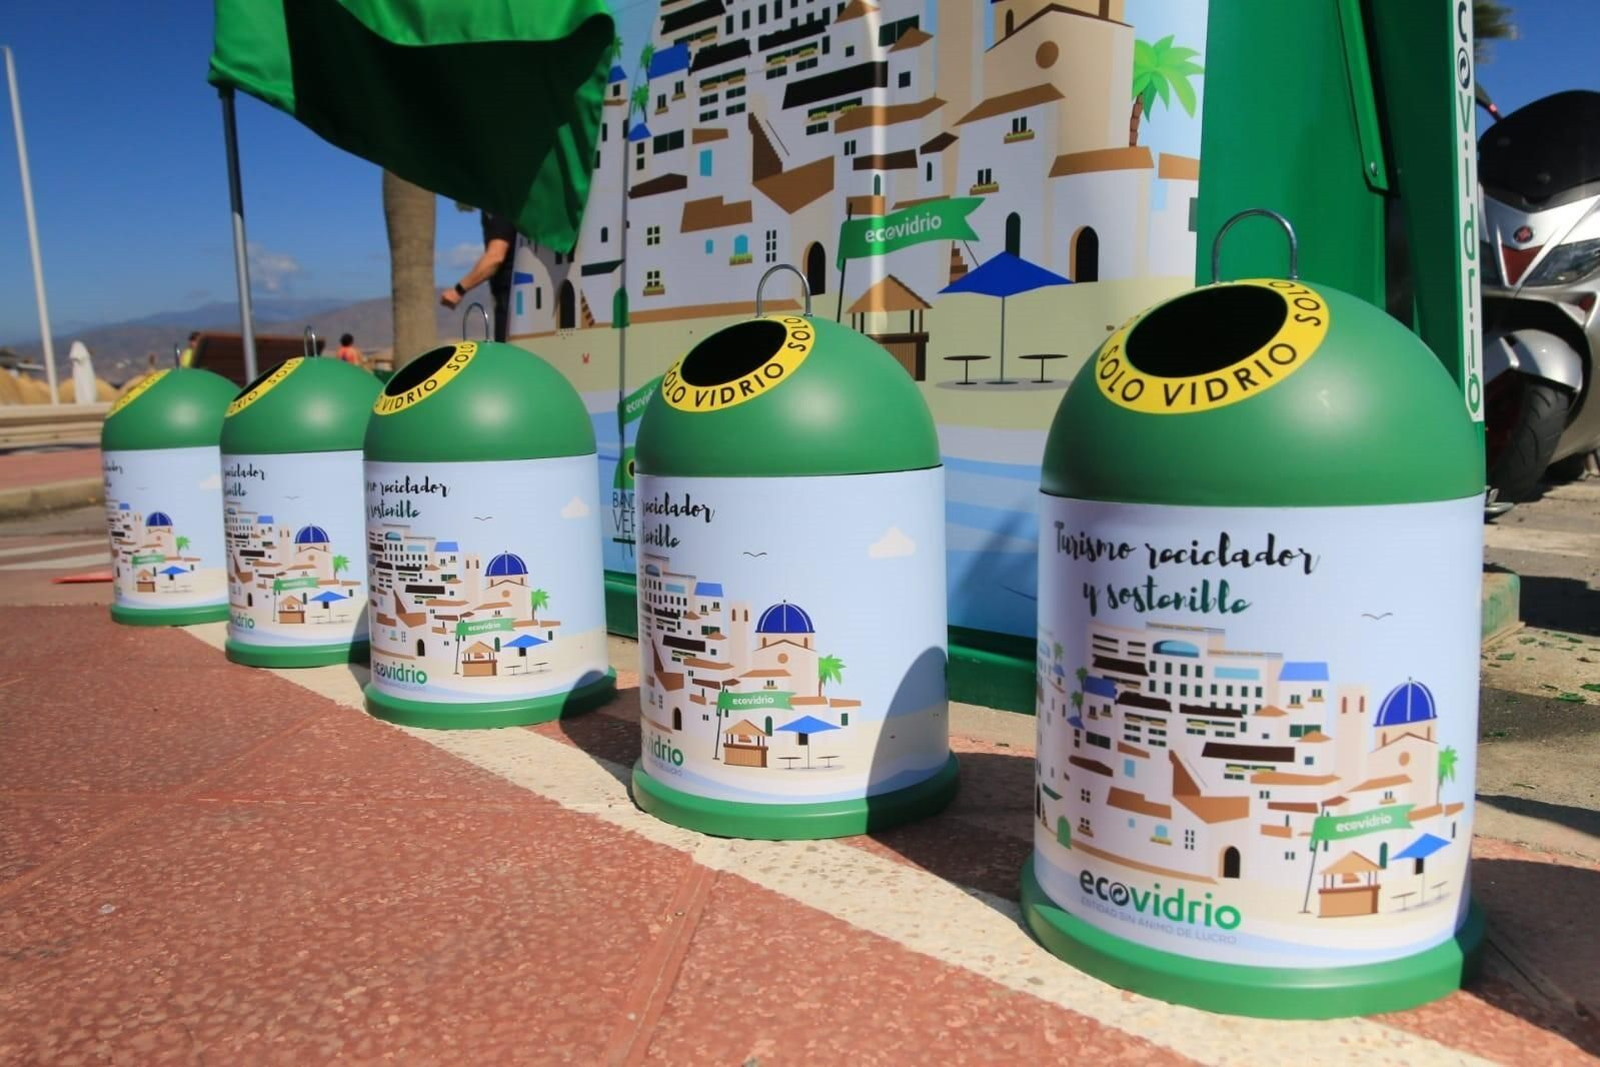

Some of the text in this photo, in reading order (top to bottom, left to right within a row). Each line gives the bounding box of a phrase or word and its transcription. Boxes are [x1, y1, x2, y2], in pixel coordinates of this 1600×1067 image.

[864, 212, 942, 243] ecovidrio
[695, 362, 784, 407] VIDRIO
[783, 317, 811, 352] SOLO
[1100, 281, 1322, 407] SOLO VIDRIO SOLO
[381, 379, 437, 411] VIDRIO
[446, 343, 476, 371] SOLO
[1054, 520, 1321, 575] Turismo reciclador
[1083, 575, 1252, 617] y sostenible
[732, 696, 775, 706] ecovidrio
[1335, 813, 1393, 833] ecovidrio
[1079, 869, 1242, 930] ecovidrio
